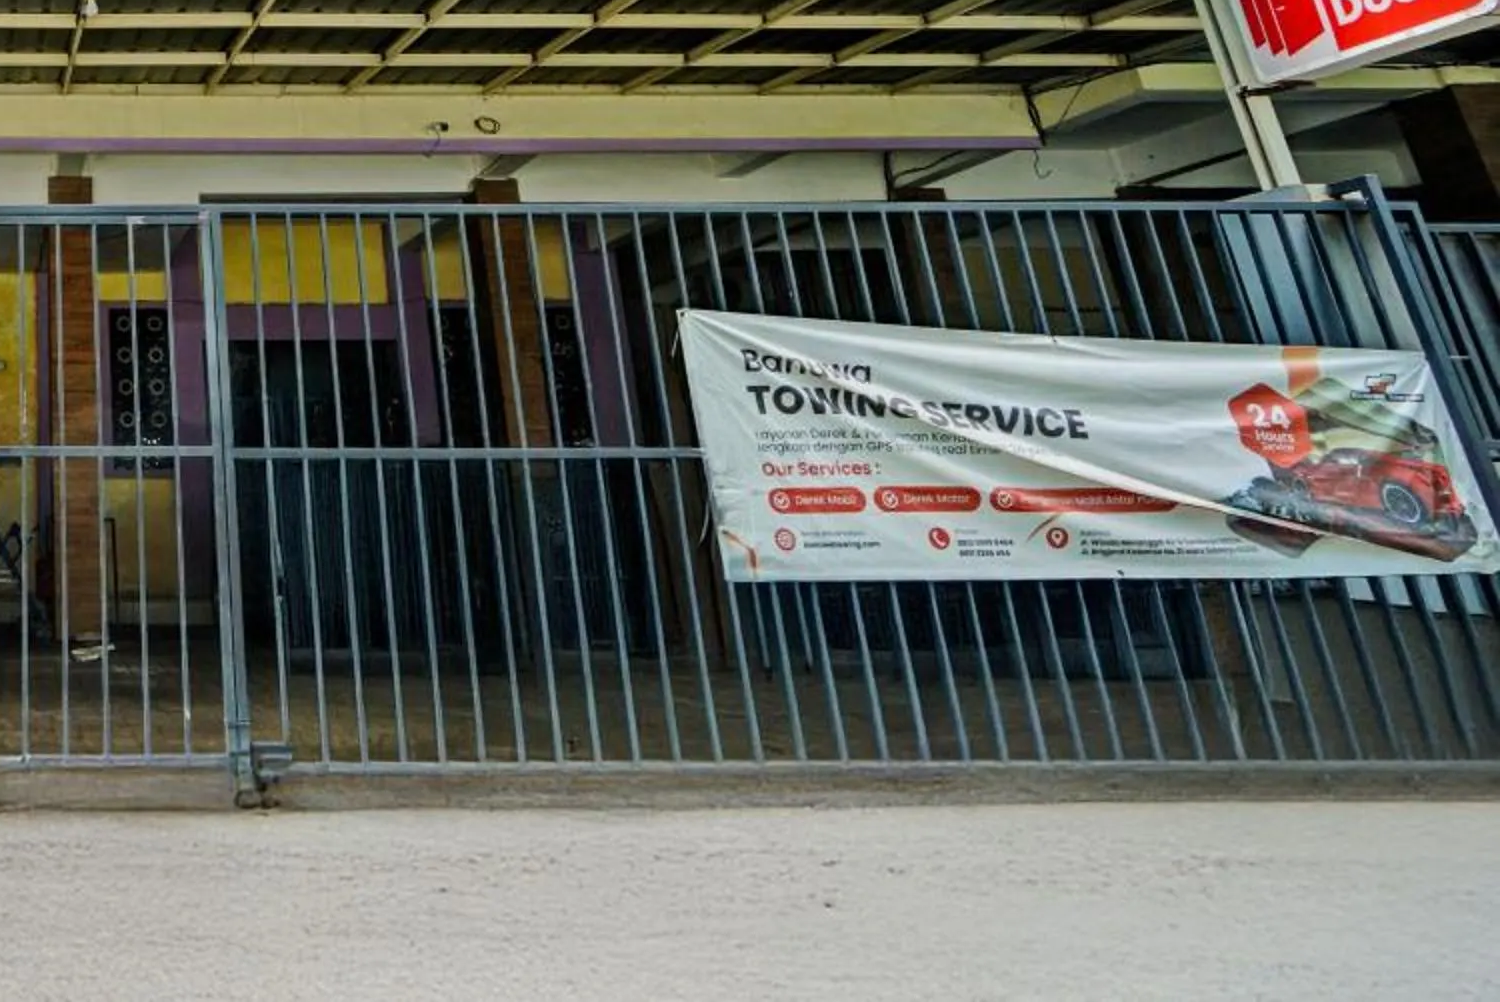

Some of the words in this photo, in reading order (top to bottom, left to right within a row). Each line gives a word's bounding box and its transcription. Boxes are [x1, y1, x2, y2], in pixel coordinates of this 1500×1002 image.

[747, 385, 917, 419] TOWING
[922, 401, 1089, 439] SERVICE
[1246, 403, 1290, 428] 24
[1256, 430, 1294, 443] Hours
[865, 441, 893, 453] GPS
[762, 461, 793, 476] Our
[797, 459, 872, 475] Services
